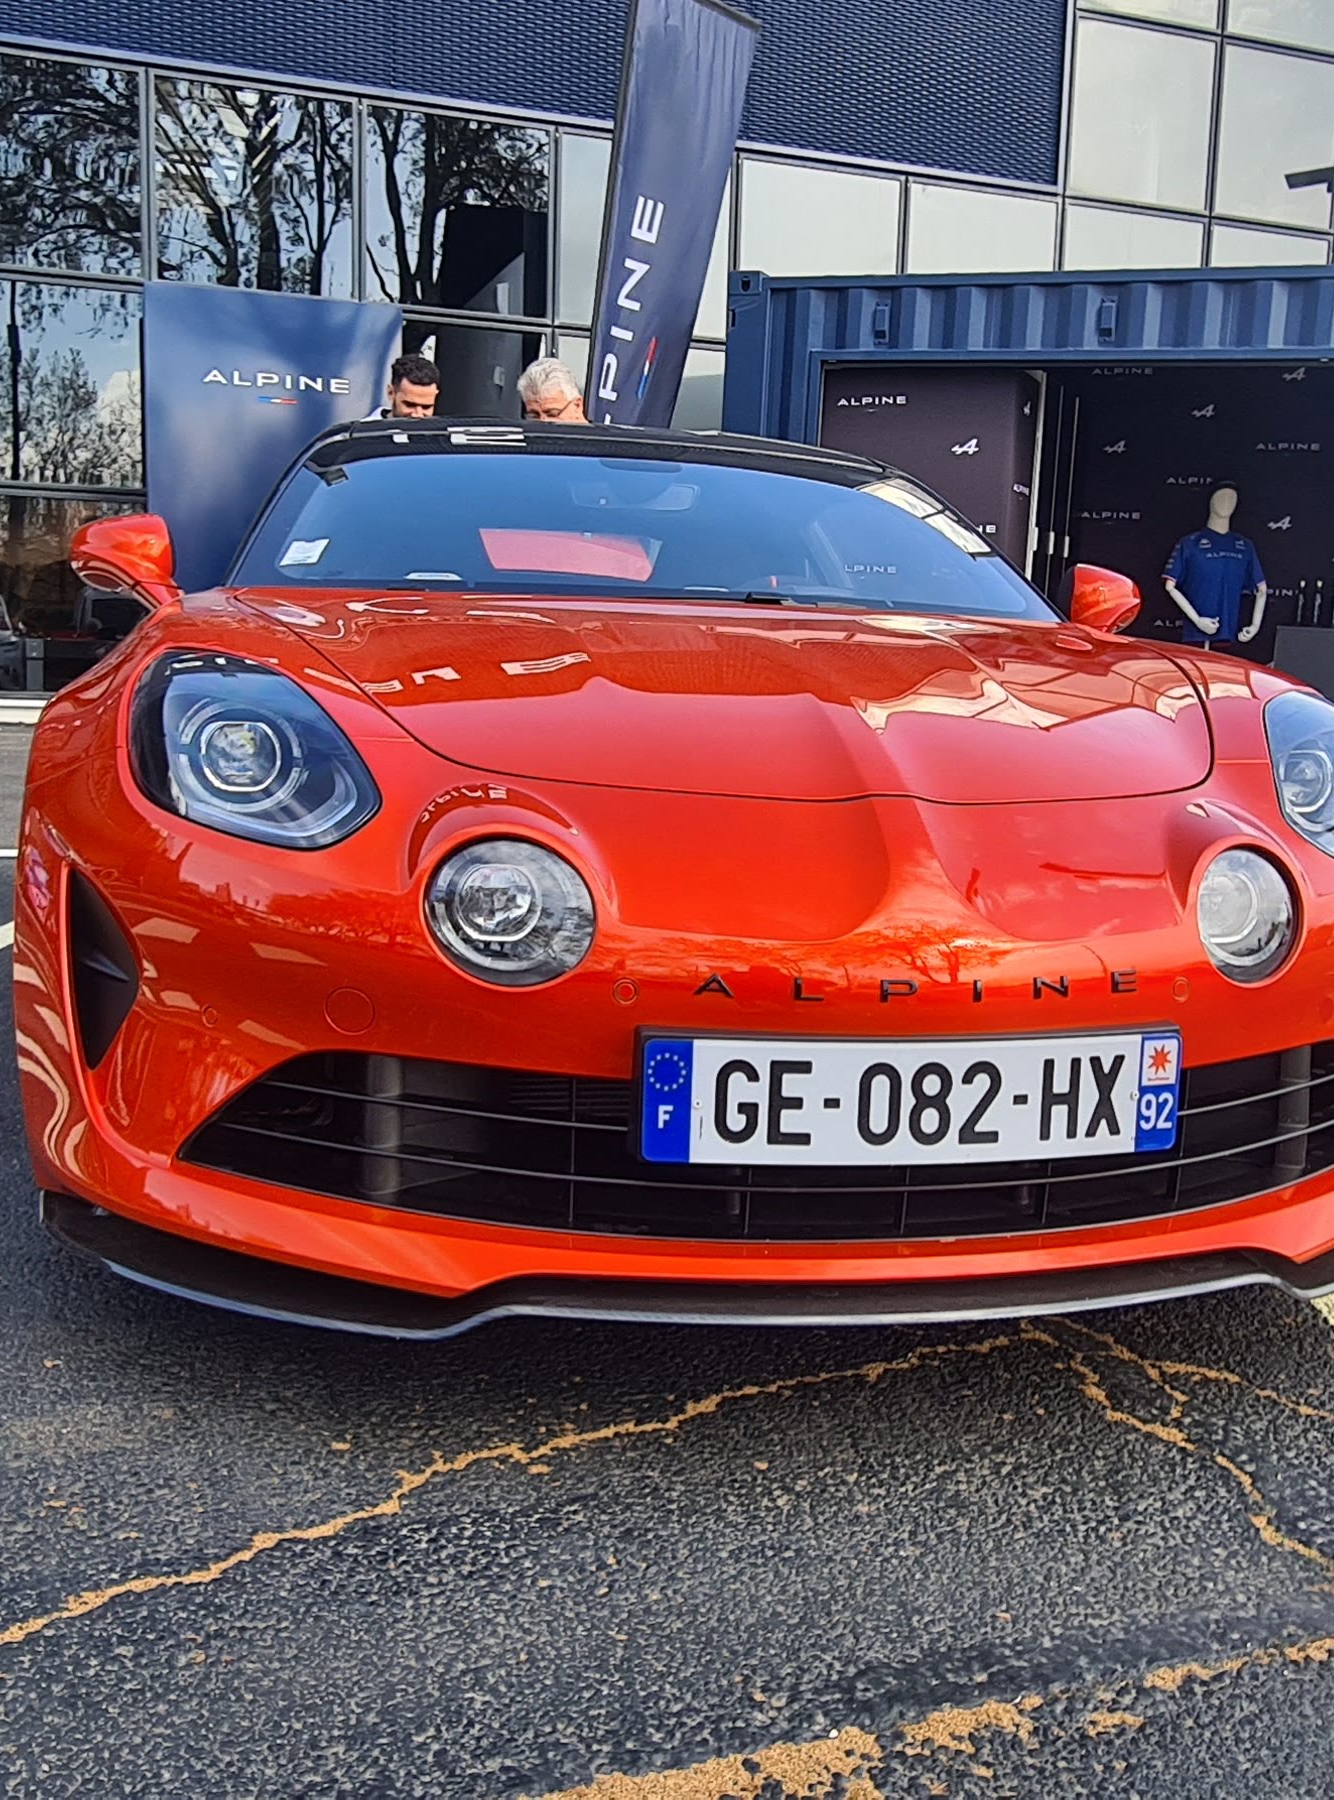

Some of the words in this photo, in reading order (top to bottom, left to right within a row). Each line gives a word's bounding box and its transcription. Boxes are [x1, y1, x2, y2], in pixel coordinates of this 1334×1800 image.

[1090, 366, 1154, 376] ALPINE
[202, 369, 351, 395] ALPINE
[837, 395, 908, 406] ALPINE
[1254, 441, 1322, 452] ALPINE
[1165, 476, 1214, 485] ALPIN
[1080, 510, 1142, 520] ALPINE
[844, 564, 898, 574] LPINE
[692, 969, 1138, 1004] ALPINE
[713, 1054, 1126, 1146] GE-082-HX
[657, 1104, 675, 1130] F
[1139, 1091, 1175, 1132] 92
